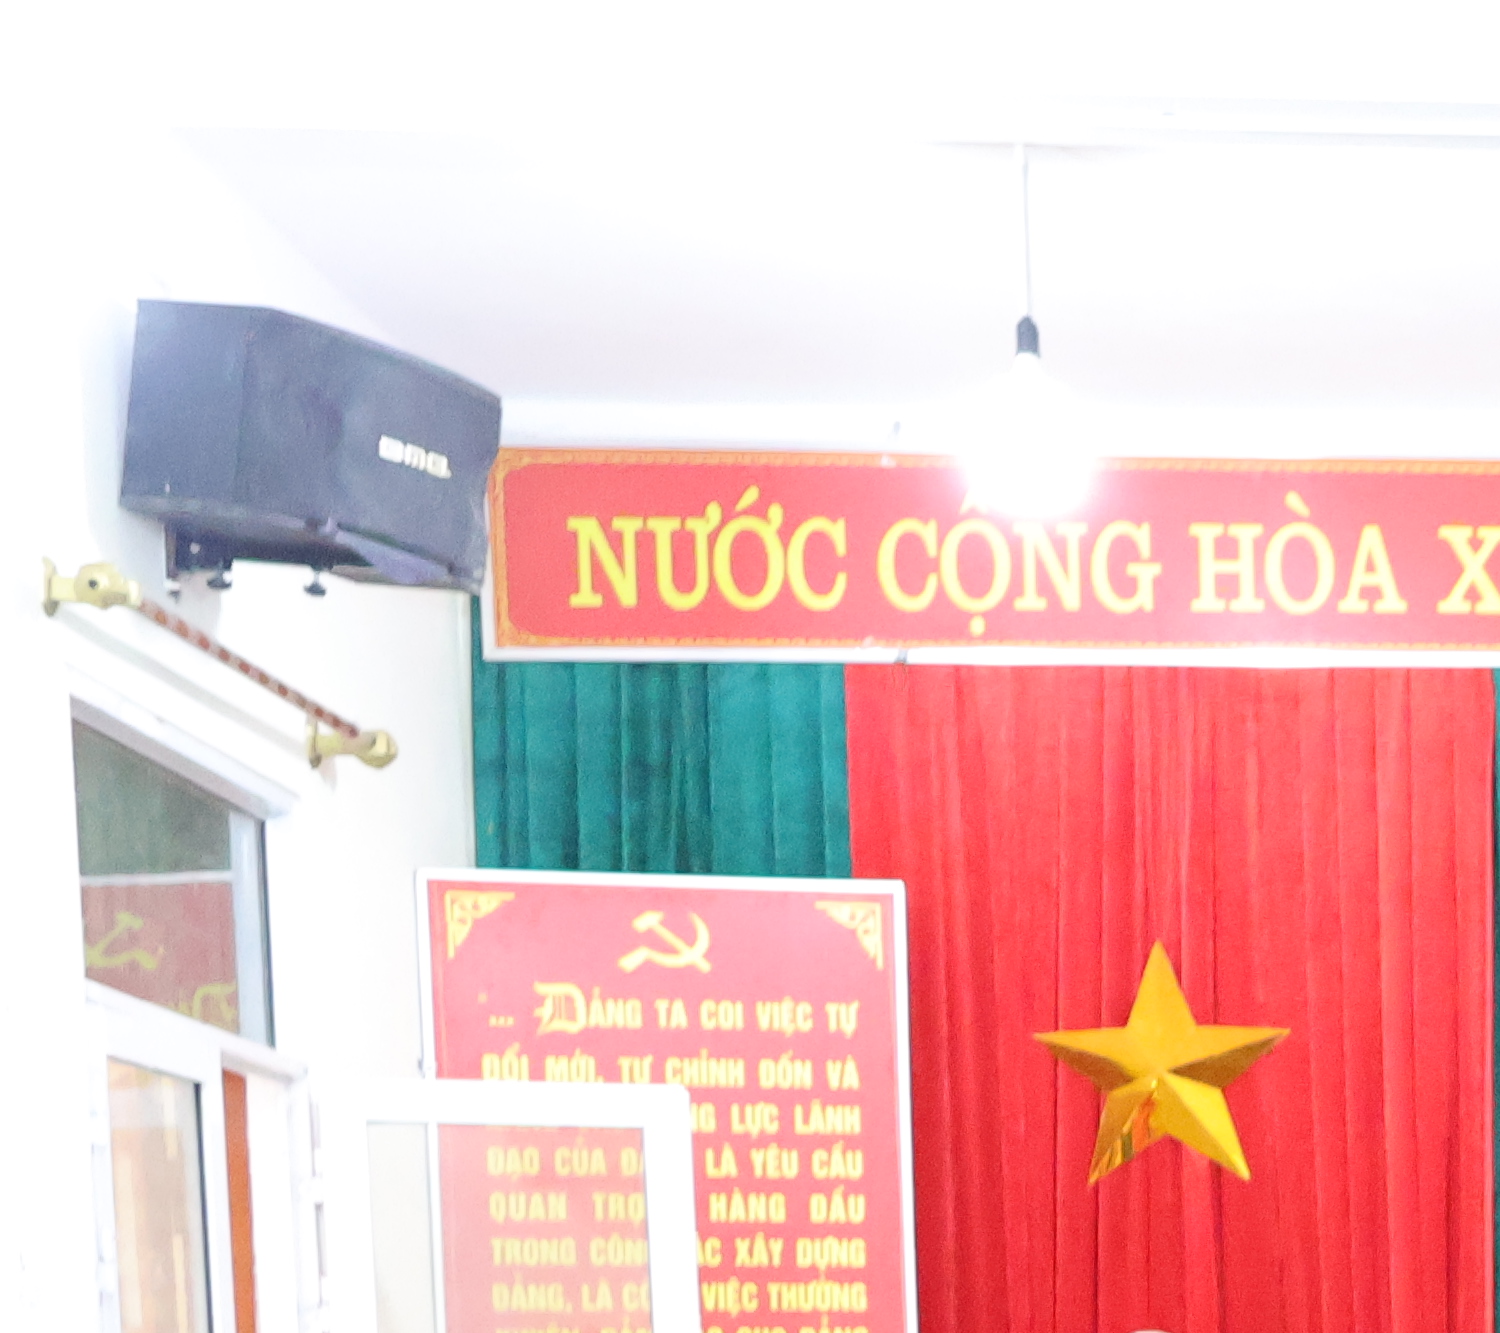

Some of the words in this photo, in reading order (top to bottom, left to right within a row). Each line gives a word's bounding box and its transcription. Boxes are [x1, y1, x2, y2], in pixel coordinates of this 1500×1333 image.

[569, 486, 848, 610] NƯỚC
[877, 494, 1161, 637] CỘNG
[1190, 492, 1407, 617] HÒA
[656, 998, 688, 1030] TA
[700, 999, 744, 1031] COI
[756, 996, 813, 1037] VIỆC
[825, 1055, 860, 1090] VÀ
[705, 1142, 738, 1179] LÀ
[489, 1192, 568, 1224] QUAN
[592, 1191, 645, 1228] TRỌ
[491, 1236, 577, 1267] TRONG
[589, 1232, 648, 1266] CÔN
[734, 1232, 784, 1267] XÂY
[581, 1277, 613, 1312] LÀ
